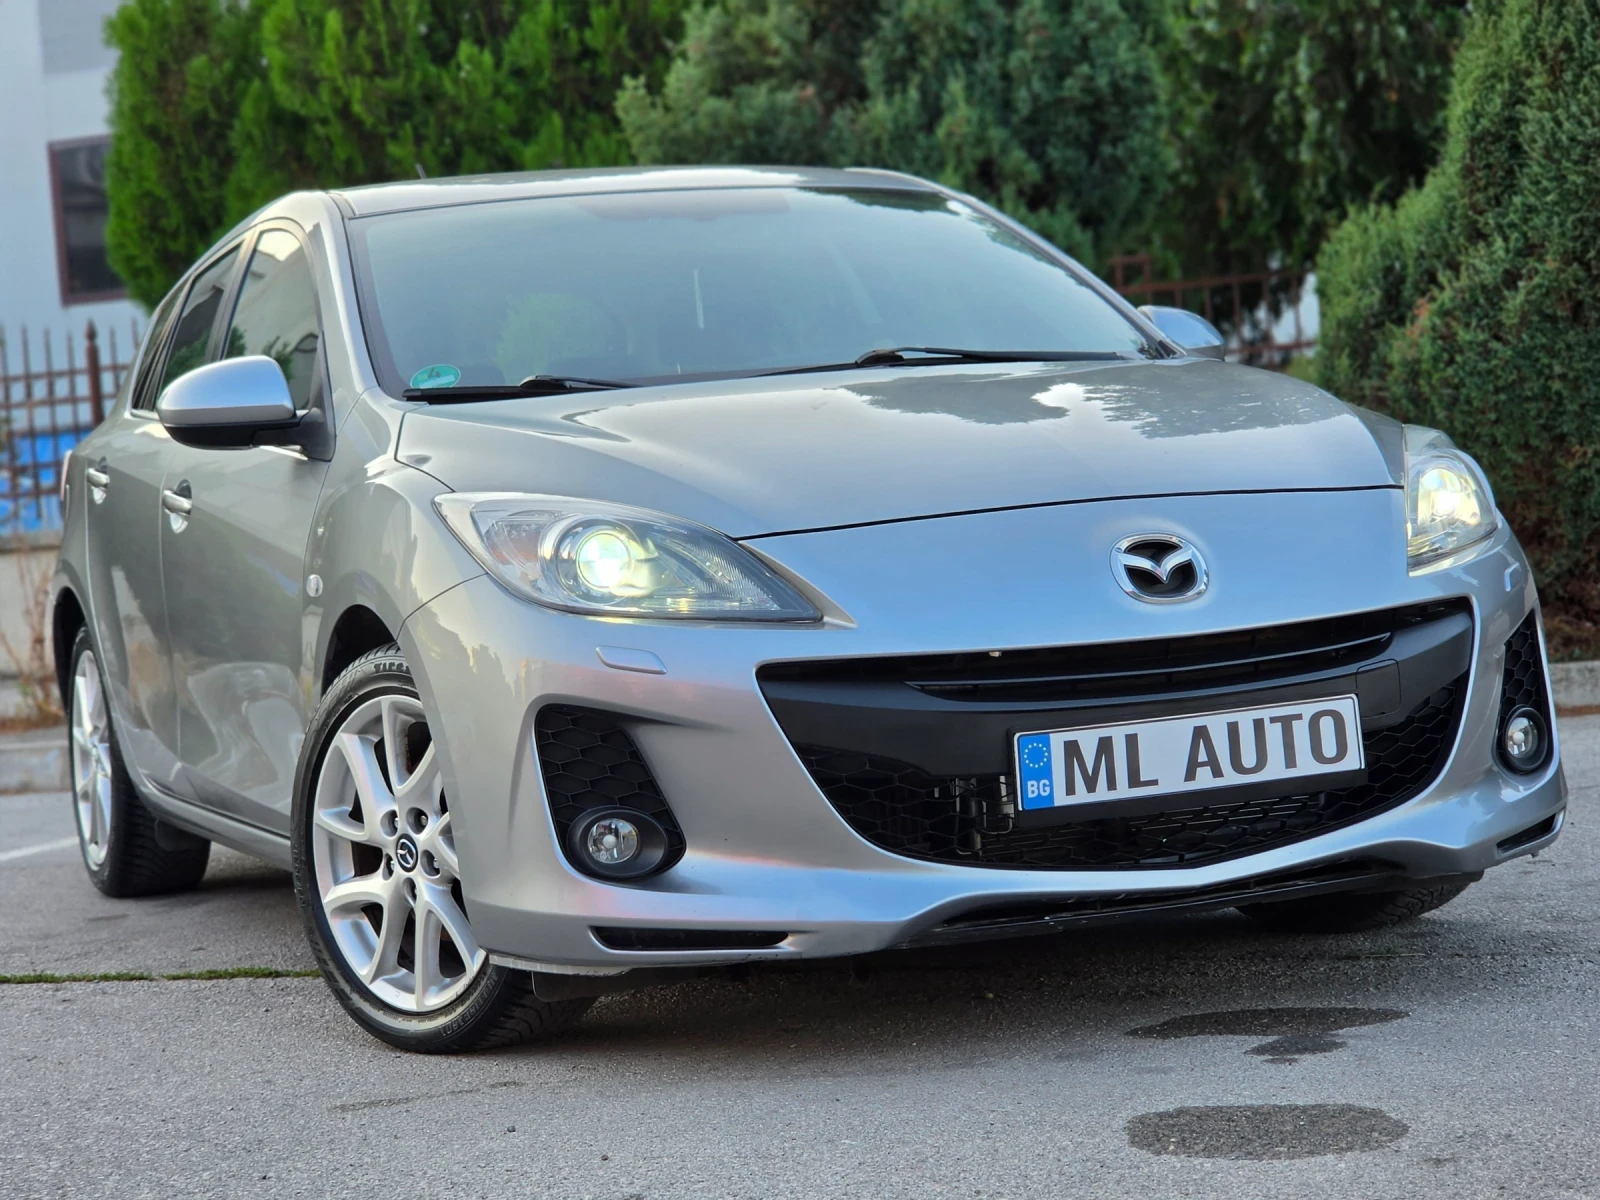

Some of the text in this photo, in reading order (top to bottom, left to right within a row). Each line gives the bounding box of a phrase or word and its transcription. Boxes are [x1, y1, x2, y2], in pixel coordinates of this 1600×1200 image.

[1063, 708, 1349, 797] ML AUTO
[1027, 779, 1050, 799] BG
